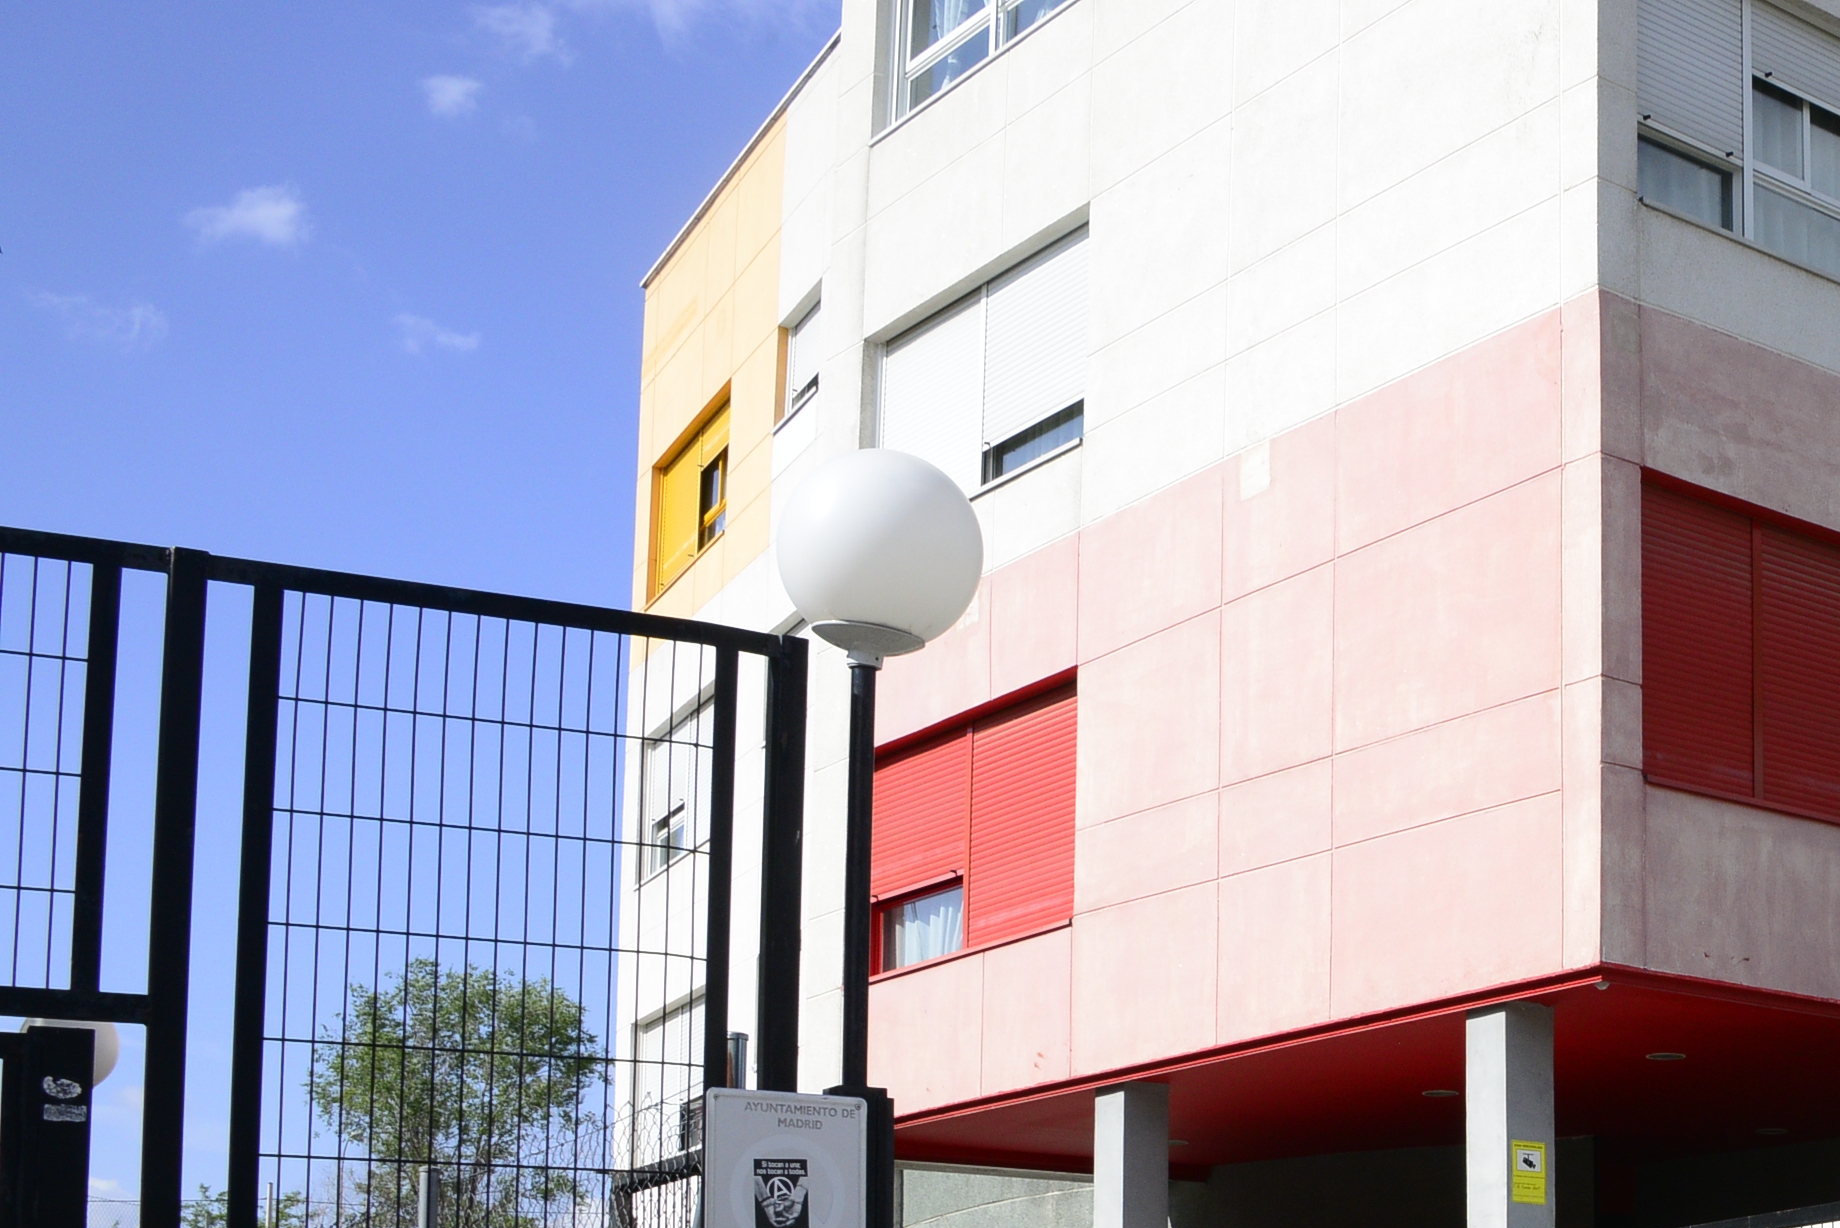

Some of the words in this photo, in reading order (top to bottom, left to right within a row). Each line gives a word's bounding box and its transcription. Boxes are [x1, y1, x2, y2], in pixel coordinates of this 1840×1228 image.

[744, 1101, 838, 1116] AYUNTAMIENTO
[841, 1108, 856, 1119] DE
[777, 1118, 823, 1130] MADRID
